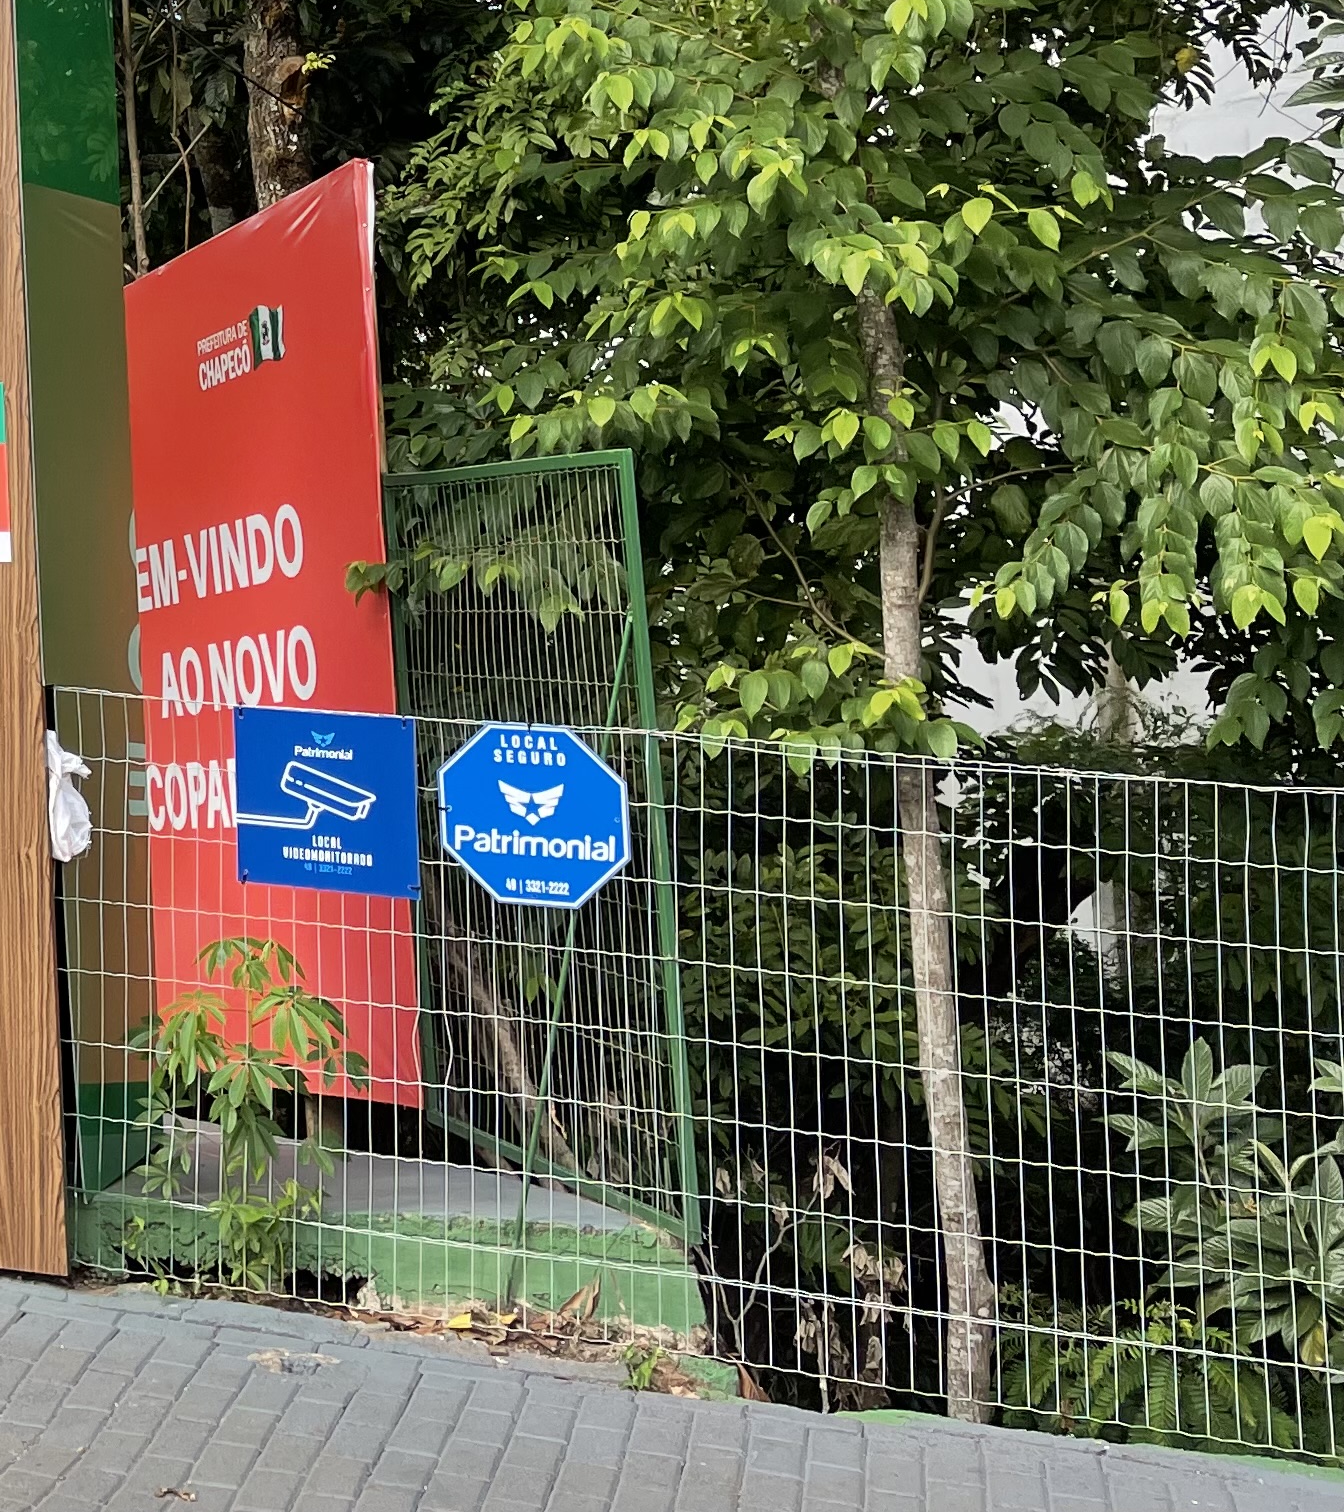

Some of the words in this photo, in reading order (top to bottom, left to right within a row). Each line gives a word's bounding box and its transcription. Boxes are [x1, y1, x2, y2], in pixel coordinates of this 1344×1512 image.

[196, 325, 238, 356] PREFEITURA
[237, 319, 249, 338] DE
[198, 338, 251, 391] CHAPECÓ
[136, 504, 304, 613] EM-VINDO
[162, 646, 205, 720] AO
[208, 625, 317, 712] NOVO
[294, 745, 353, 761] Patrimonial
[499, 734, 558, 751] LOCAL
[493, 748, 566, 767] SEGURO
[282, 846, 373, 867] VIDEOMONITORADO
[312, 834, 343, 850] LOCAL
[454, 824, 616, 863] Patrimonial
